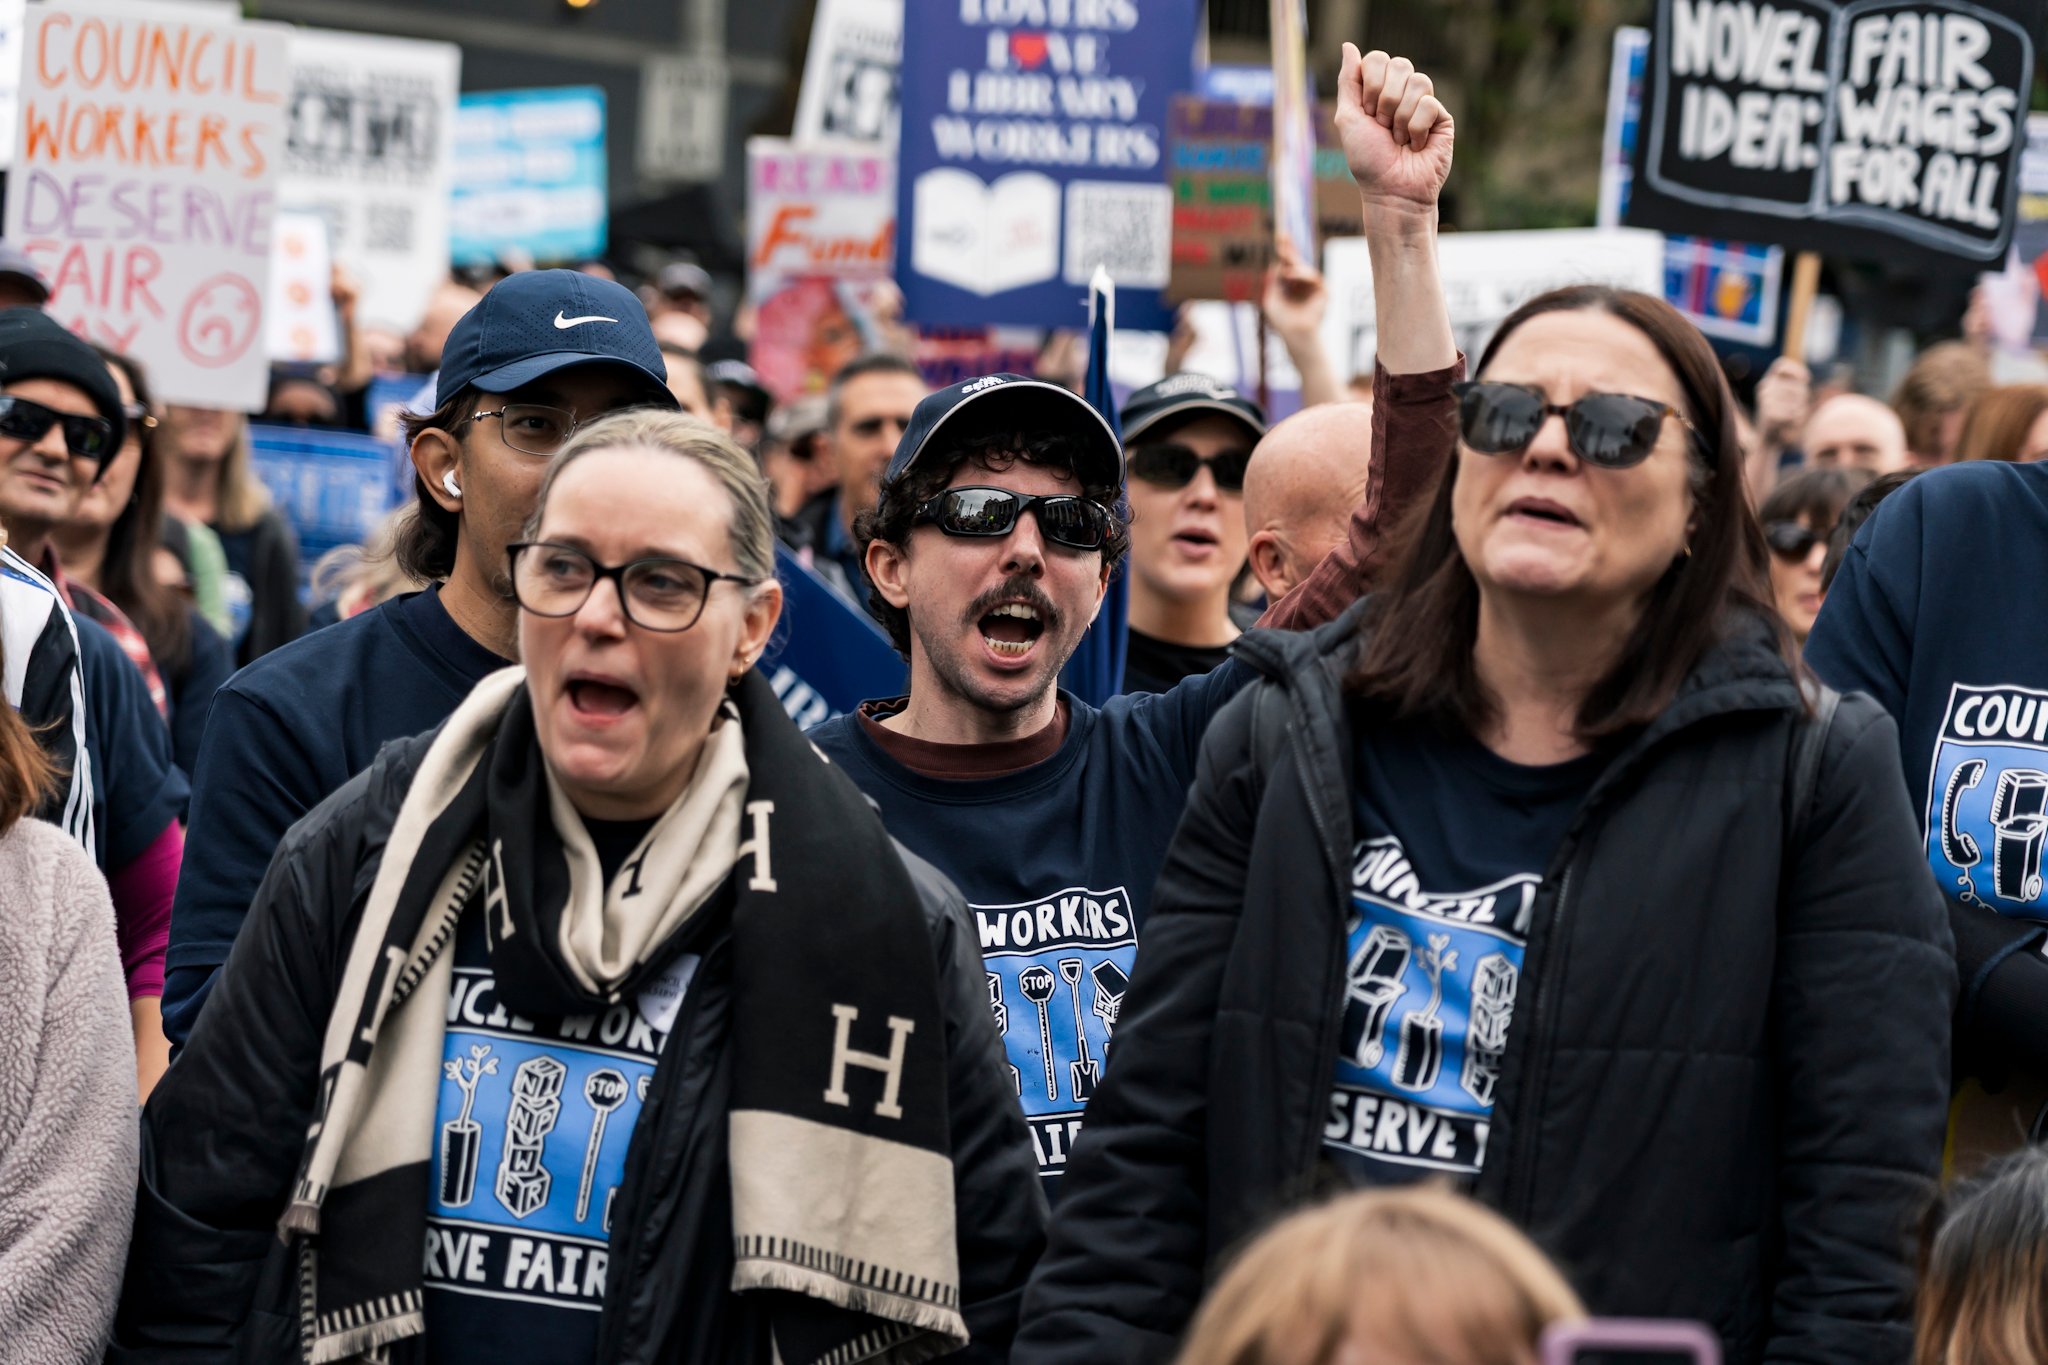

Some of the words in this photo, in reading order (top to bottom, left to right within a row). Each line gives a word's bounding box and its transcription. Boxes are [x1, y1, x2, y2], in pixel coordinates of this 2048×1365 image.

[36, 11, 284, 104] COUNCIL
[1672, 0, 1828, 90] NOVEL
[1850, 12, 1996, 90] FAIR
[947, 67, 1146, 122] LIBRARY
[1679, 83, 1824, 172] IDEA:
[1838, 83, 2018, 157] WAGES
[25, 93, 267, 180] WORKERS
[930, 113, 1161, 169] WORKERS
[22, 168, 275, 257] DESERVE
[1829, 143, 1922, 208] FOR
[1920, 150, 2002, 231] ALL
[1022, 974, 1052, 992] STOP
[587, 1078, 625, 1099] STOP
[823, 1003, 915, 1119] H
[1324, 1092, 1458, 1158] SERVE
[504, 1237, 609, 1297] FAIR
